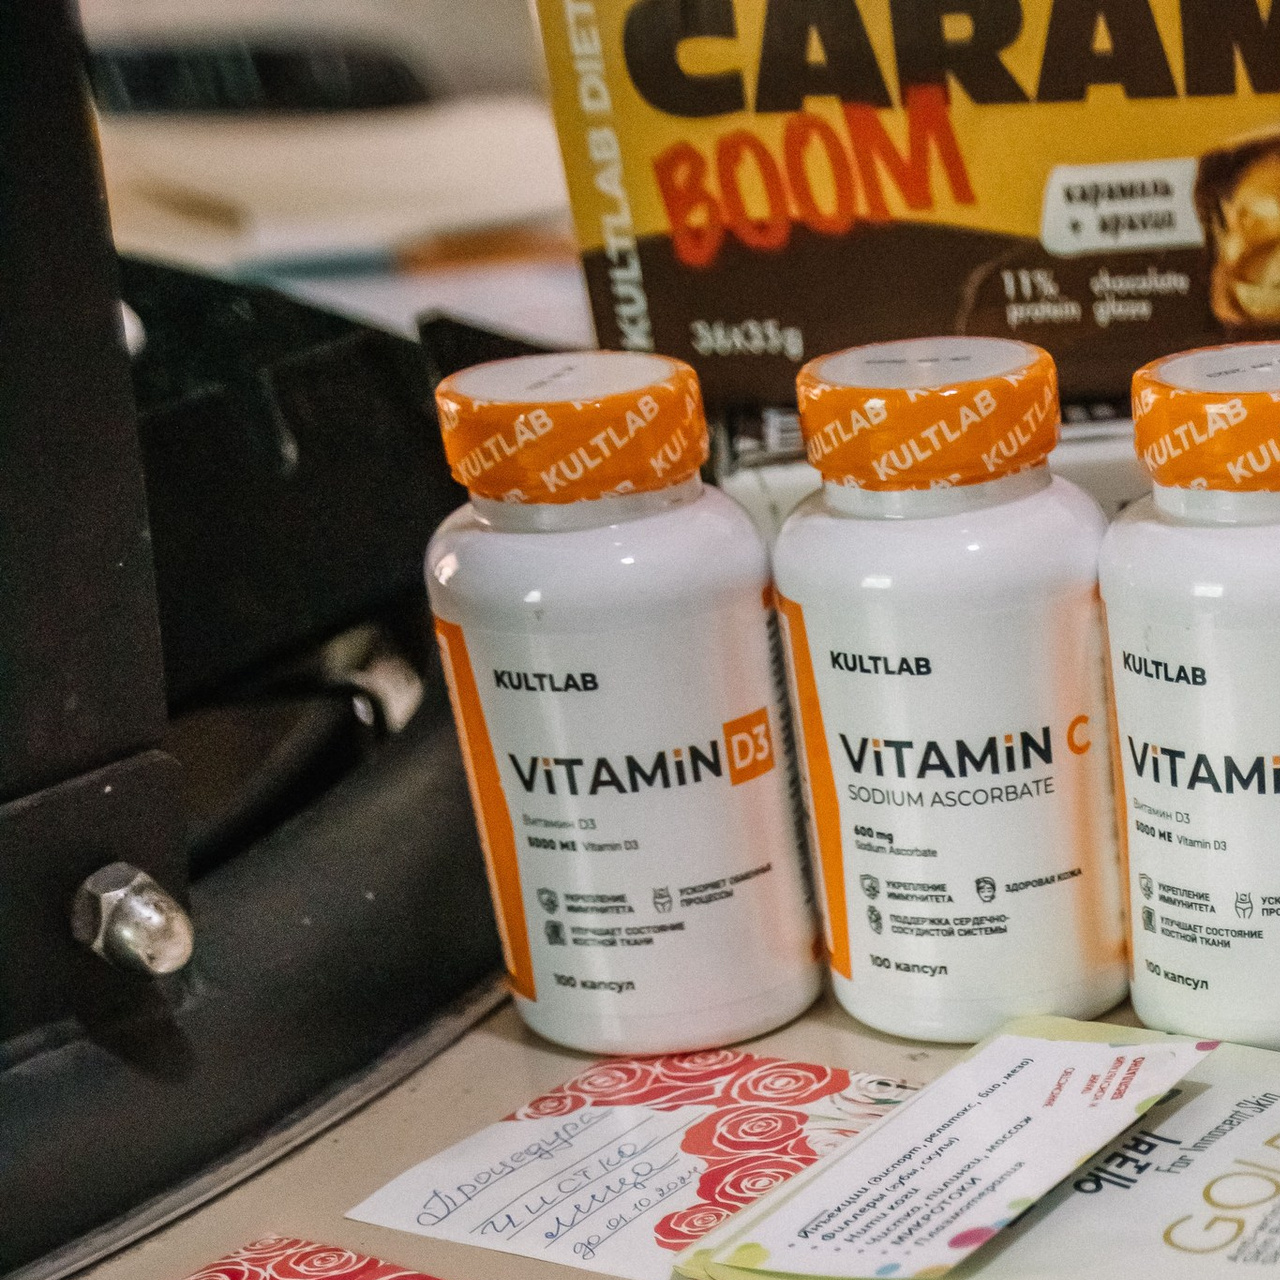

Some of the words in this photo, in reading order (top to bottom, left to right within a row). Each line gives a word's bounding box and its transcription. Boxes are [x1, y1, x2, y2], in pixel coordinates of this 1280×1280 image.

[651, 83, 976, 269] BOOM
[455, 408, 554, 485] KULTLAB
[539, 395, 661, 493] KULTLAB
[870, 389, 999, 482] KULTLAB
[1142, 397, 1249, 473] KULTLAB
[830, 650, 932, 677] KULTLAB
[1122, 650, 1208, 687] KULTLAB
[493, 668, 599, 693] KULTLAB
[729, 722, 771, 770] D3
[1066, 713, 1092, 756] C
[847, 783, 925, 808] SODIUM
[930, 776, 1056, 808] ASCORBATE
[578, 817, 598, 831] D3
[1175, 810, 1191, 825] D3
[854, 824, 875, 838] 600
[876, 830, 894, 845] mg
[1175, 834, 1211, 851] Vitamin
[1214, 839, 1227, 852] D3
[889, 844, 938, 858] Ascorbate
[1004, 875, 1057, 893] ЗДОРОВАЯ
[1199, 935, 1232, 950] ТКАНИ
[1205, 926, 1264, 940] СОСТОЯНИЕ
[869, 953, 892, 970] 100
[894, 959, 949, 978] капсул
[1163, 968, 1210, 991] капсул
[1155, 1154, 1195, 1175] For
[1179, 1104, 1252, 1154] Innocent
